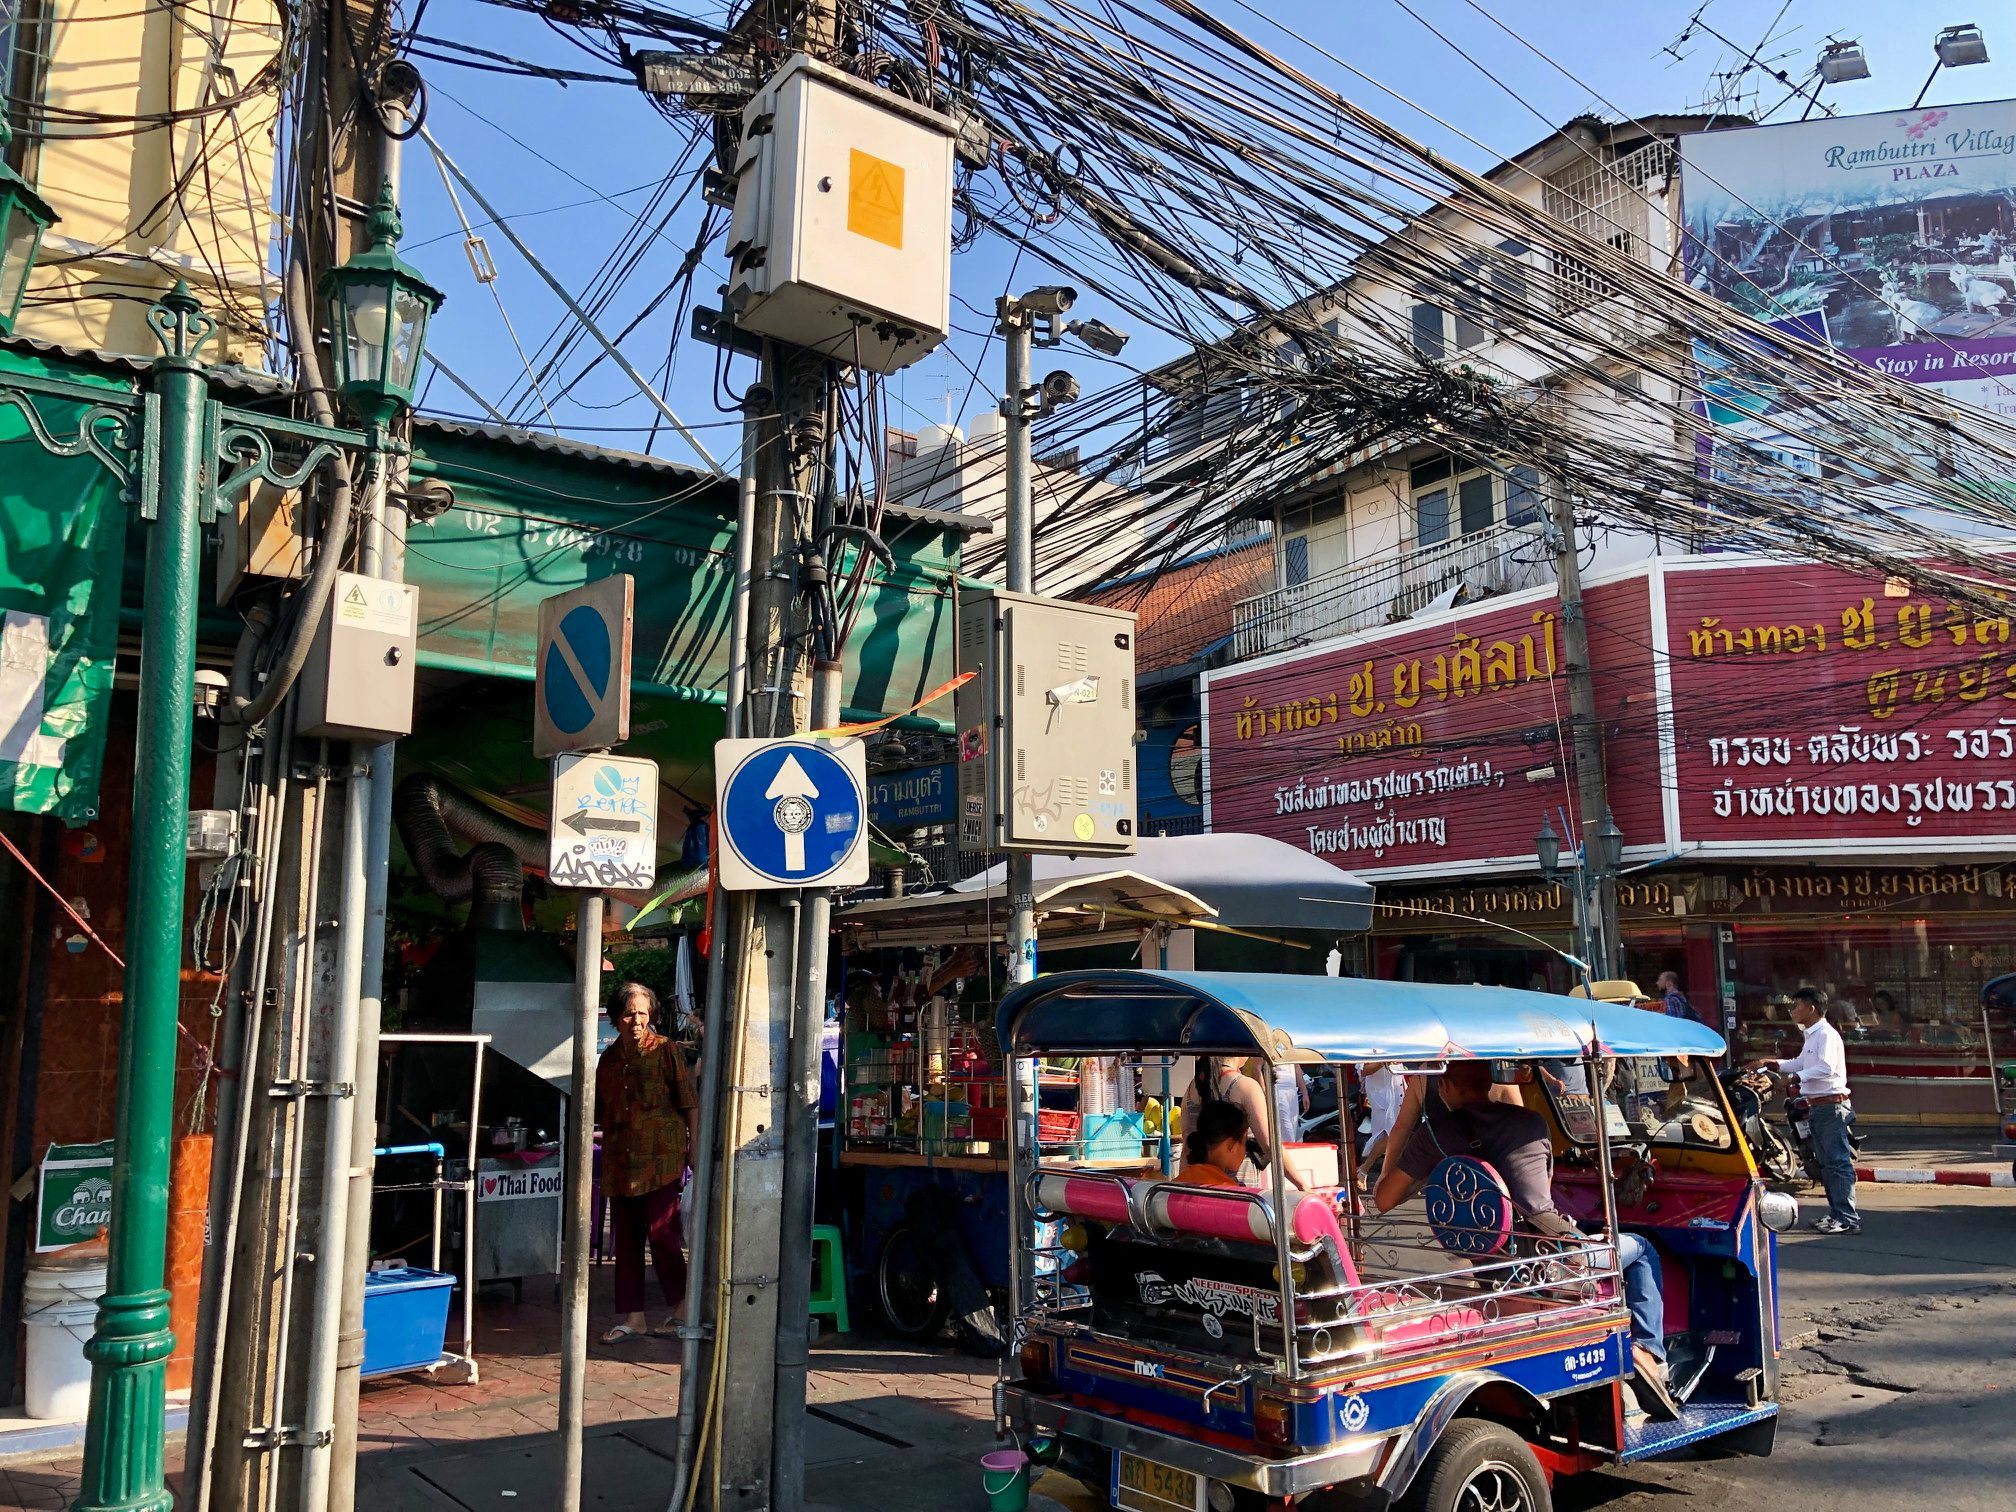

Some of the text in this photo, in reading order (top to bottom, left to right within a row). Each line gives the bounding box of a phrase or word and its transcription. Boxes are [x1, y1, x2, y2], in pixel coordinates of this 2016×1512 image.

[1824, 128, 2016, 170] Rambuttri Villag
[1892, 163, 1960, 182] PLAZA
[1875, 357, 1919, 377] Stay
[1924, 353, 1945, 371] in
[1688, 615, 1827, 657] ห้างทอง
[1235, 690, 1340, 741] ห้างทอง
[897, 803, 943, 819] RAMBUTTRI
[497, 1173, 527, 1196] Thai
[529, 1171, 562, 1194] Food
[55, 1205, 112, 1227] Chan
